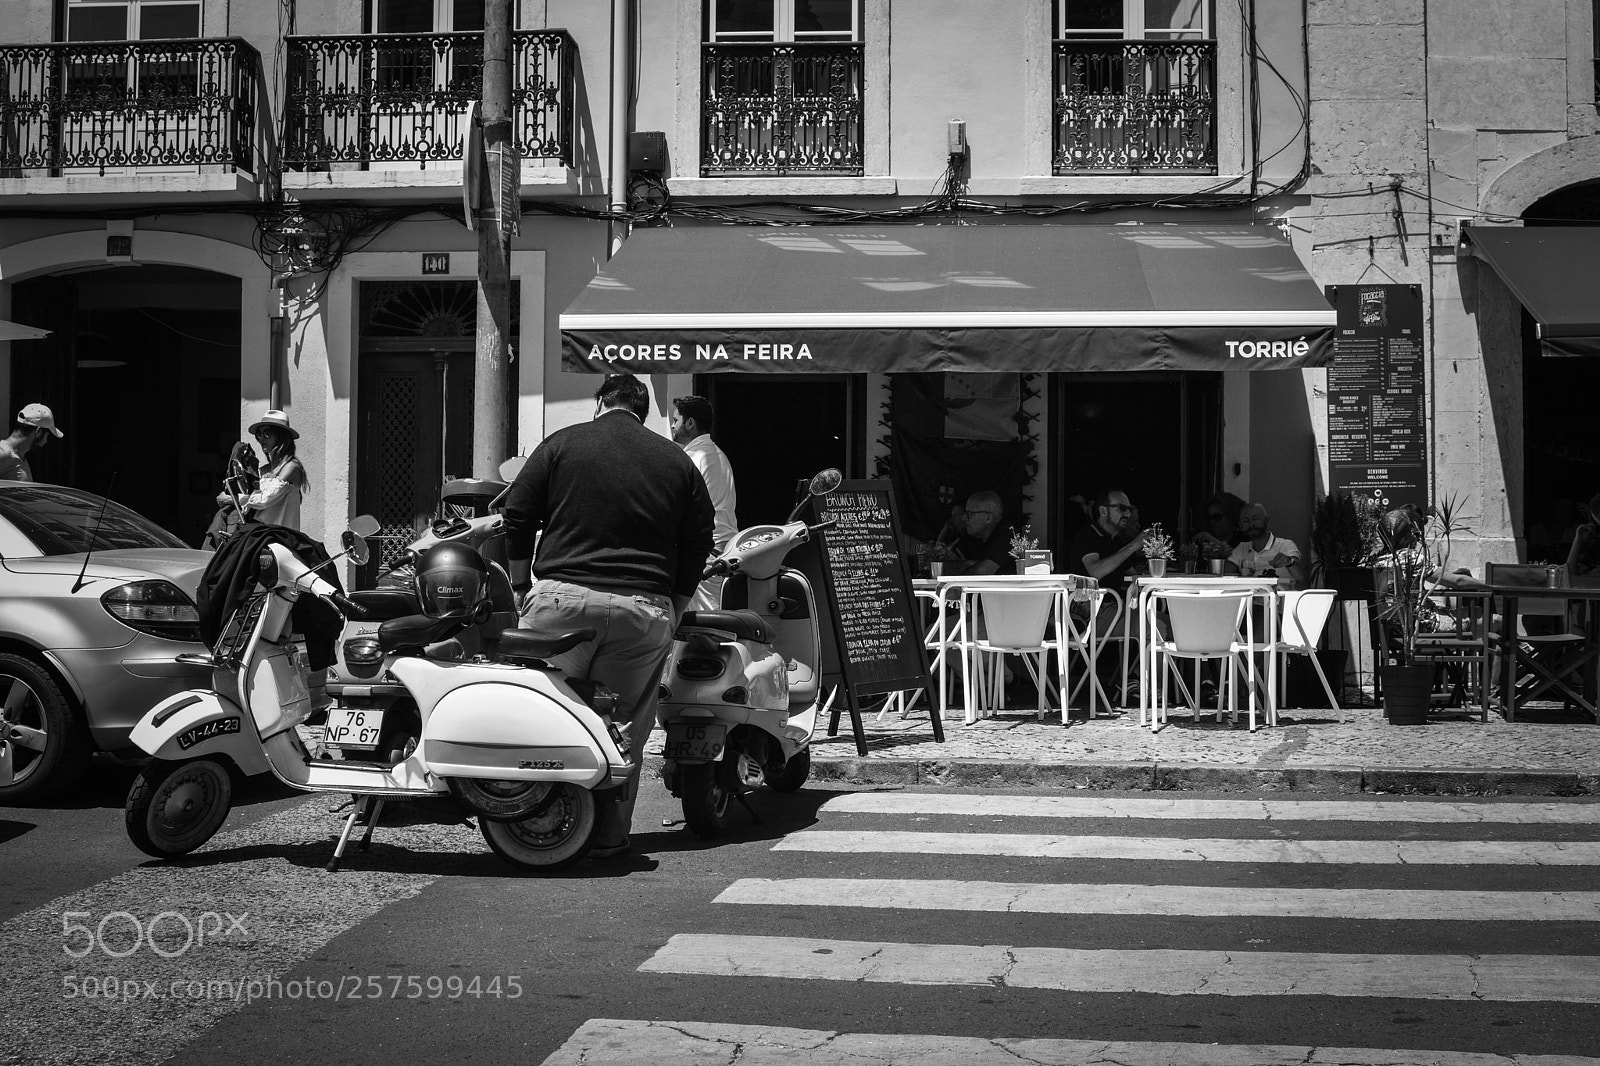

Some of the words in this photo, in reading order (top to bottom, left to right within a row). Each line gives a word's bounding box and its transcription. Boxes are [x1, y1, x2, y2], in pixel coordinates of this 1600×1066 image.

[587, 344, 682, 363] AÇORES
[696, 344, 729, 360] NA
[743, 344, 813, 360] FEIRA
[825, 492, 856, 507] BRUNCH
[437, 586, 464, 594] Climax
[347, 712, 366, 727] 76
[180, 719, 239, 747] LV-44-23
[686, 726, 706, 741] 05
